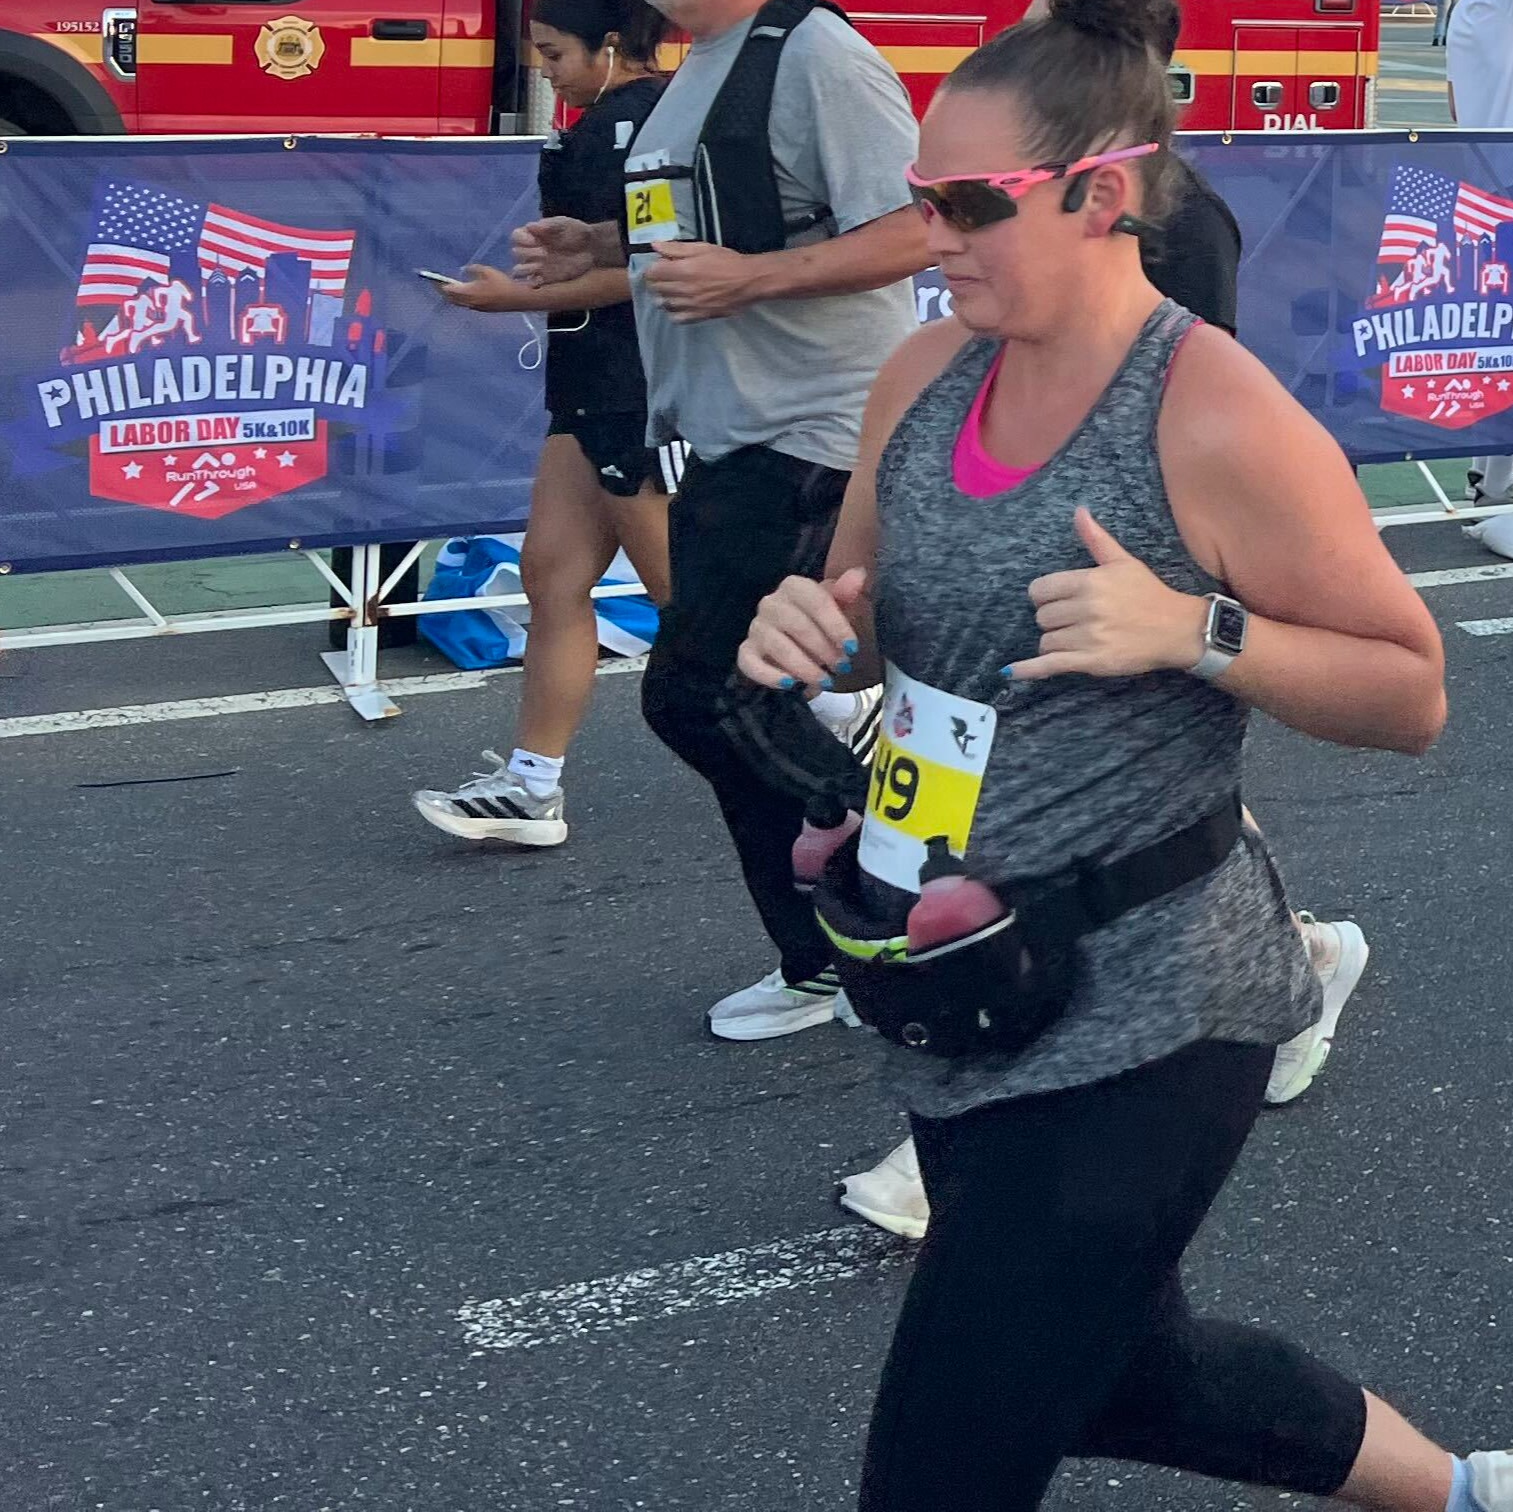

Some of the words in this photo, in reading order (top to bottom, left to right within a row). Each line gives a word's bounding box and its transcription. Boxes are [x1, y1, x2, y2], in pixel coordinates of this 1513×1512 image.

[56, 21, 101, 33] 195152
[1263, 114, 1324, 130] DIAL
[1395, 352, 1443, 374] LABOR
[1447, 351, 1478, 370] DAY
[37, 353, 368, 428] PHILADELPHIA
[110, 419, 191, 448] LABOR
[199, 416, 241, 442] DAY
[242, 419, 310, 439] 5K&10K
[165, 465, 256, 484] RunThrough
